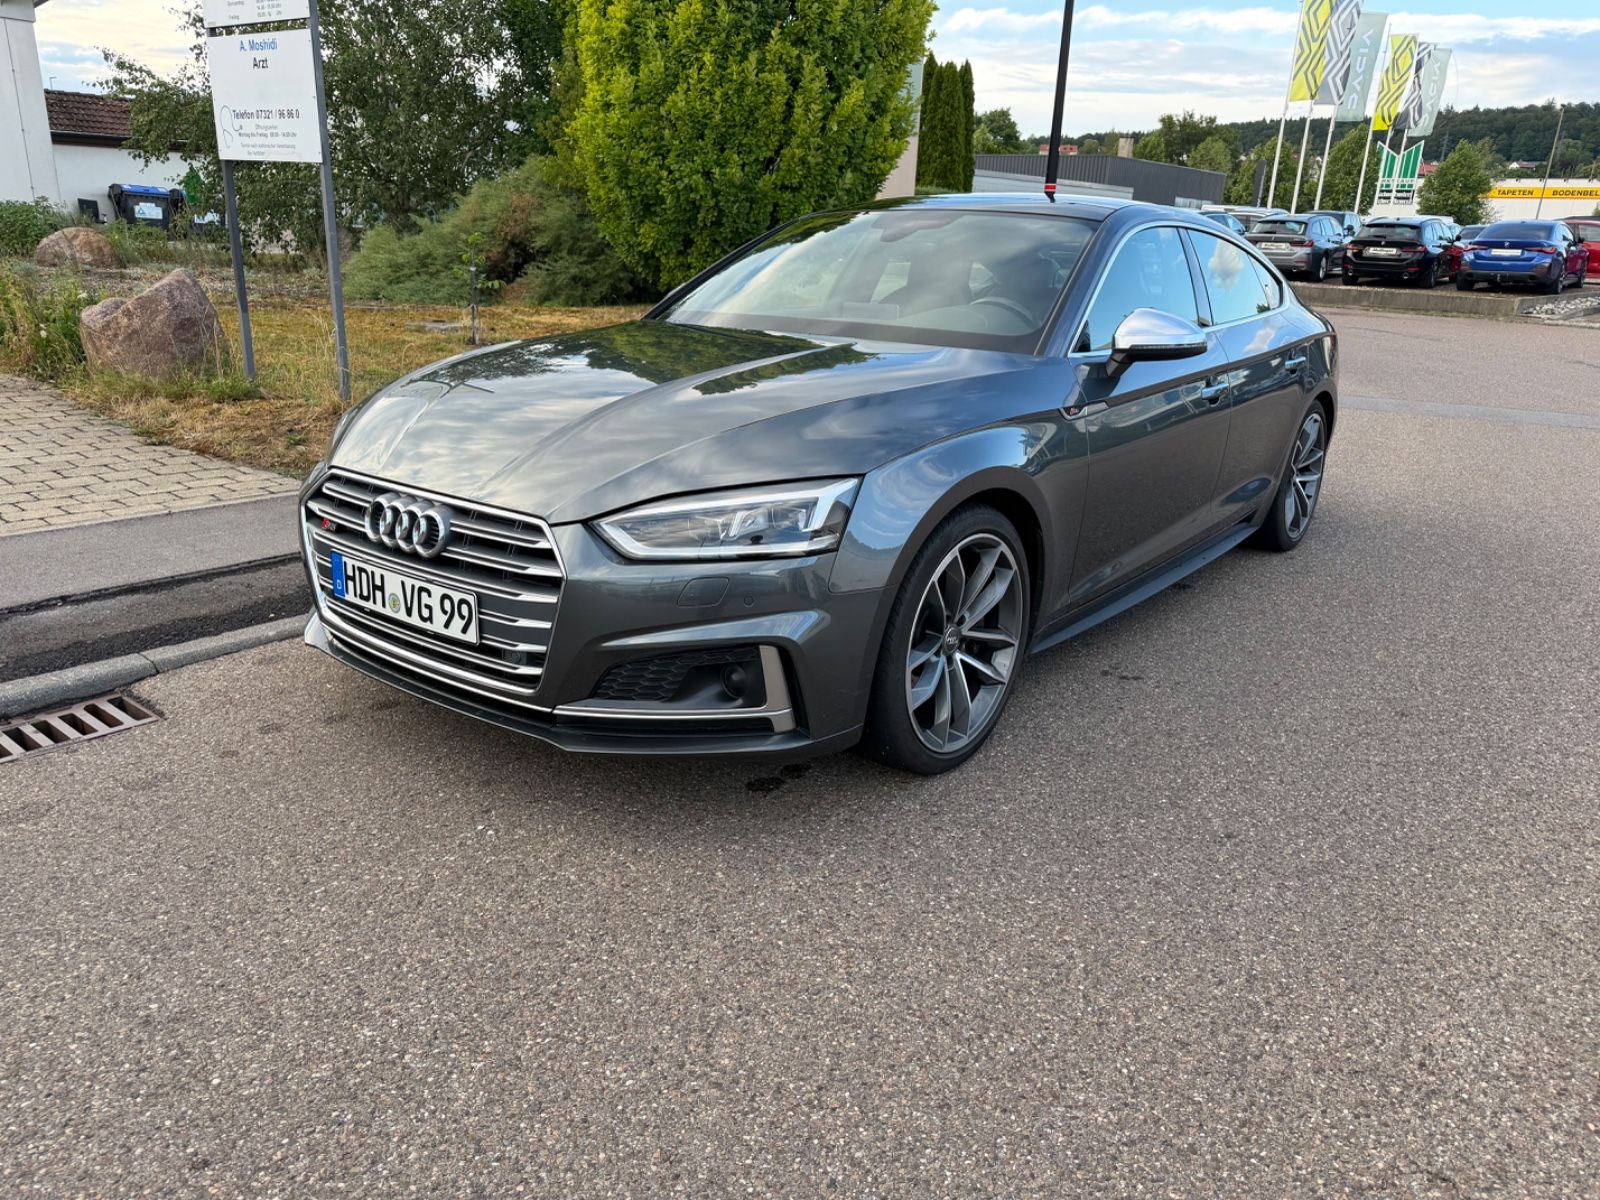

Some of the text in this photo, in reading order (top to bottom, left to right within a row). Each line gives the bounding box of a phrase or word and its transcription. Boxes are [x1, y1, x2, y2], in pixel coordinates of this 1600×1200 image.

[240, 38, 278, 52] A. Moshidi
[253, 57, 268, 69] Arzt
[1348, 28, 1374, 110] DACIA
[1420, 60, 1441, 128] DACIA
[233, 109, 255, 120] Telefon
[256, 109, 273, 120] 07321
[278, 109, 286, 119] 96
[287, 109, 294, 119] 86
[296, 109, 300, 119] 0
[336, 579, 342, 590] D
[344, 560, 474, 635] HDH VG 99
